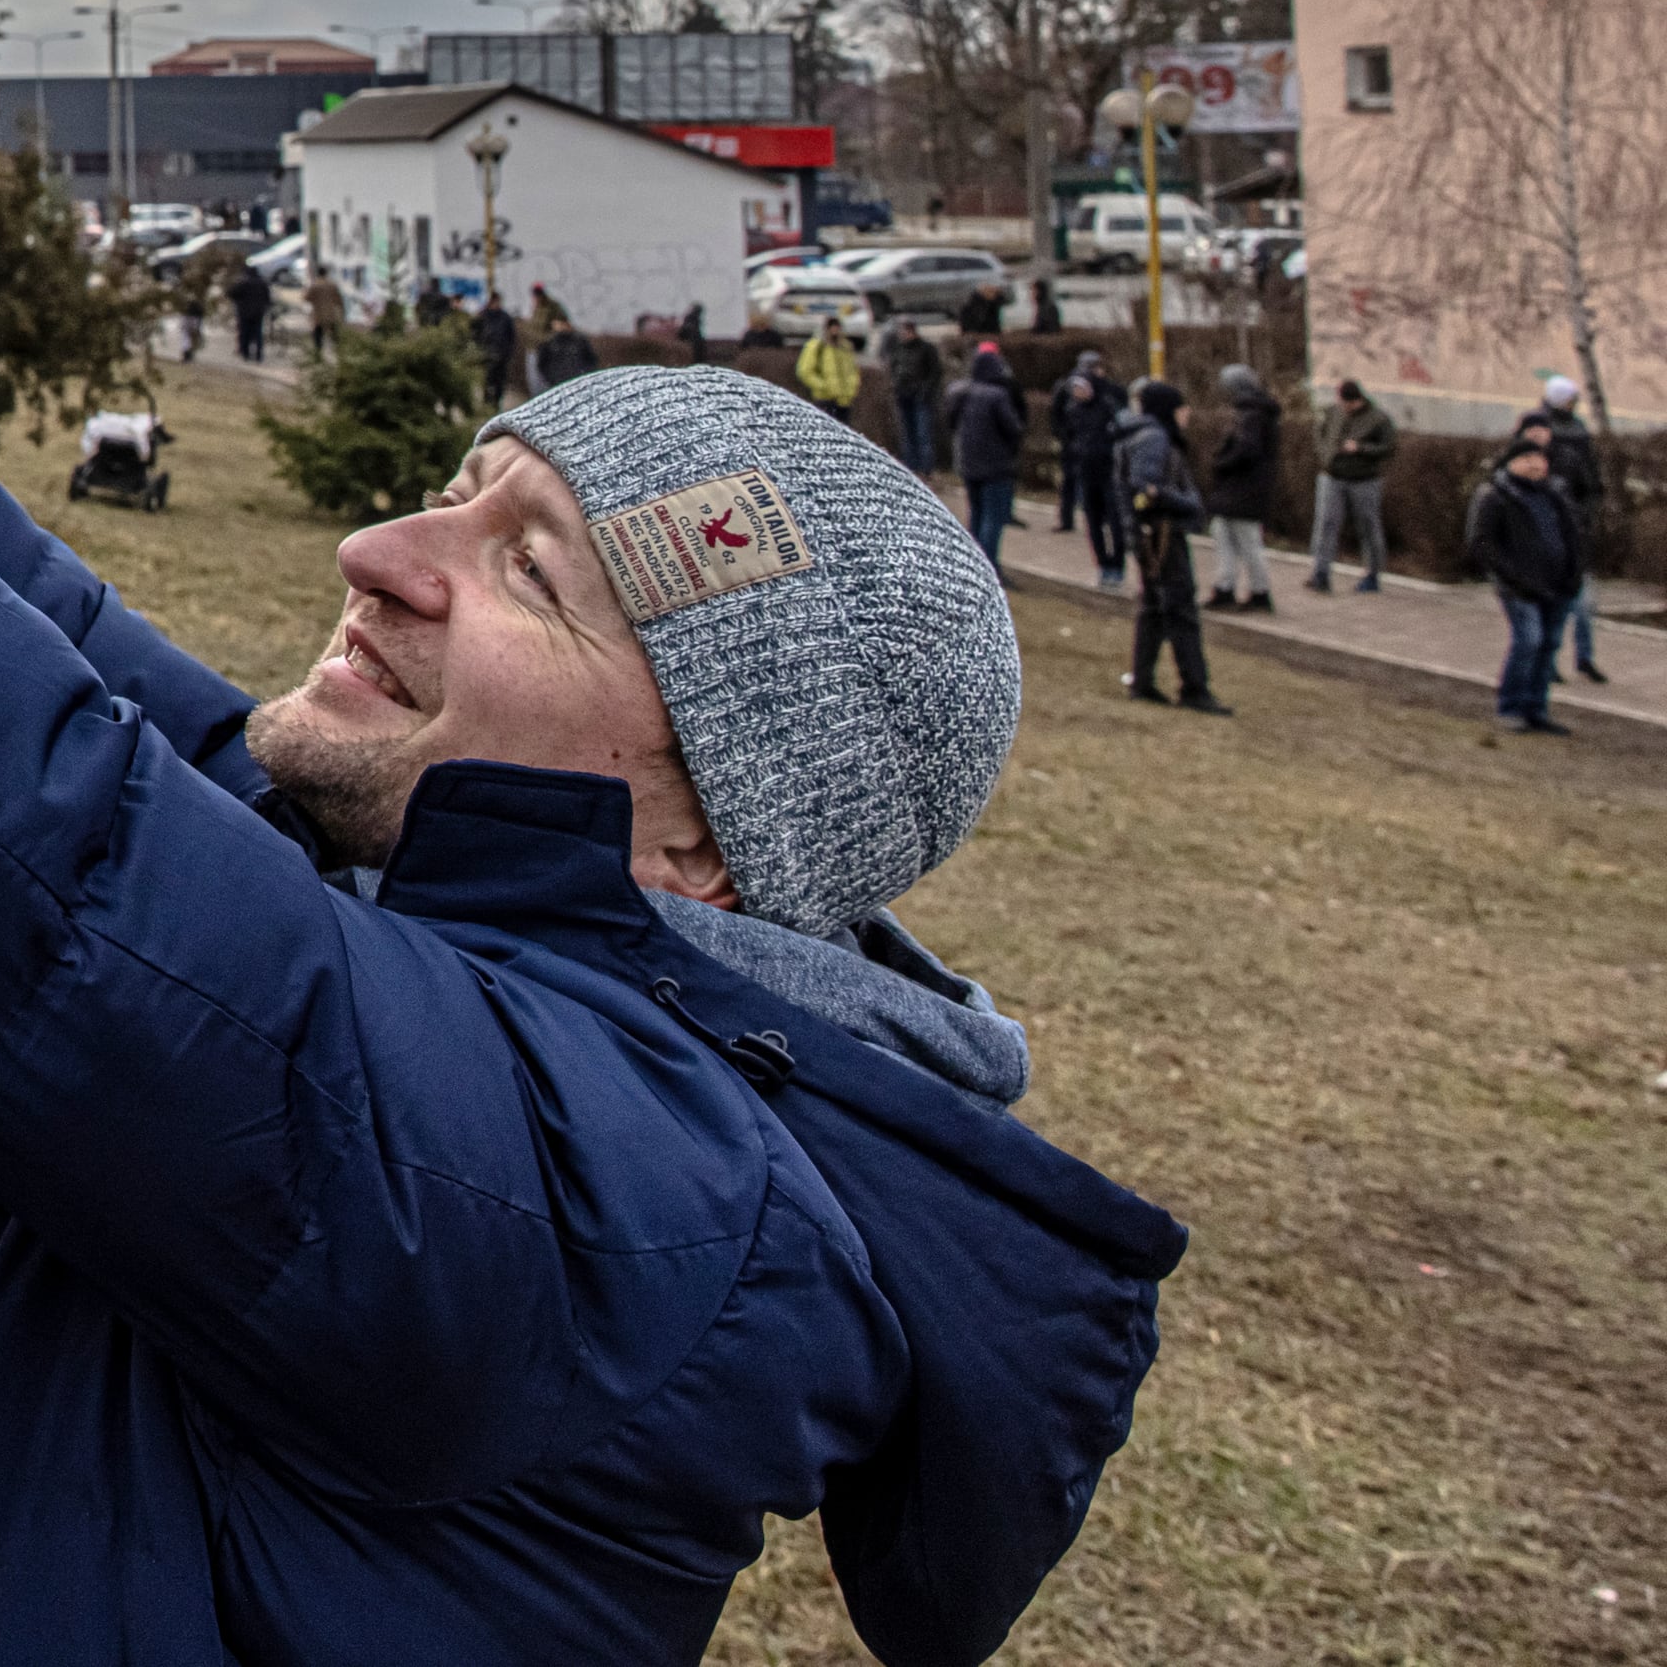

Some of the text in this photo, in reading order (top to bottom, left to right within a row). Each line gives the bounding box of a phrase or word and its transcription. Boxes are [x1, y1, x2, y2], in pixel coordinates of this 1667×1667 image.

[639, 509, 664, 544] UNION
[654, 504, 707, 591] CRAFTSMAN HERITAGE
[678, 516, 711, 568] CLOTHING
[698, 503, 736, 565] 19 62
[733, 495, 768, 555] ORIGINAL
[742, 474, 800, 566] TOM TAILOR
[596, 526, 650, 612] AUTHENTIC STYLE
[611, 518, 665, 608] STANDARD PATENTED GOODS
[638, 538, 677, 601] TRADEMARK
